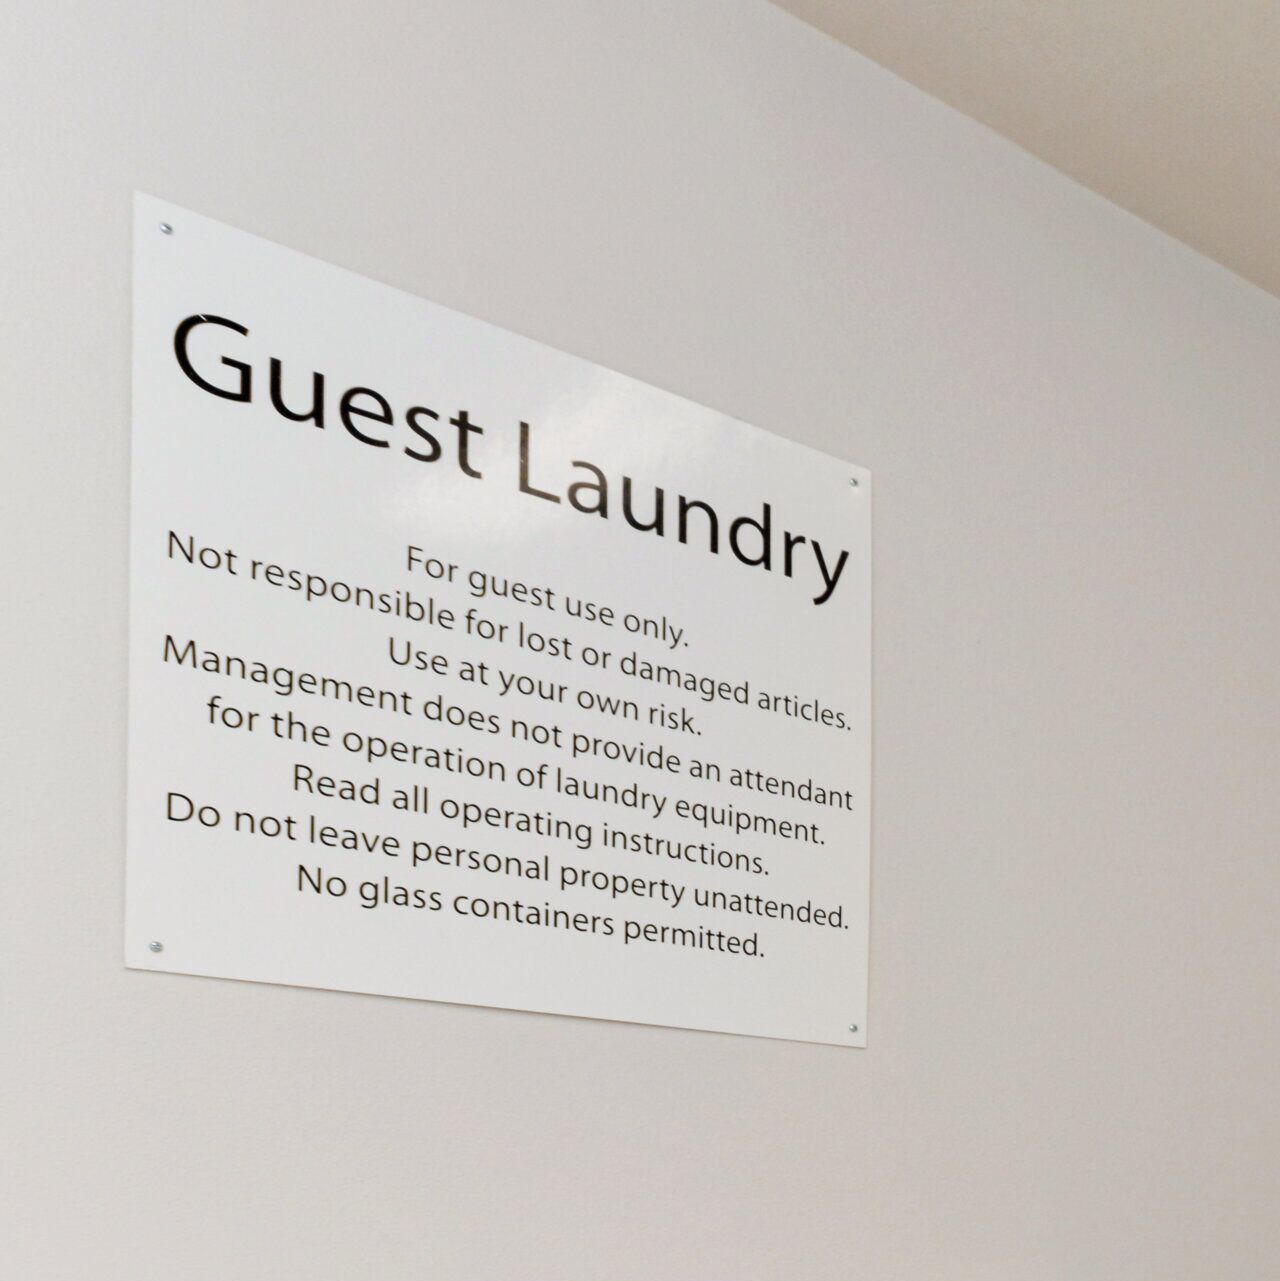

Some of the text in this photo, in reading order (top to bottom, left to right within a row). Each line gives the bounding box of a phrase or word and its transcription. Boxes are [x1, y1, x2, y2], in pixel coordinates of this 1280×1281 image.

[172, 313, 850, 606] Guest Laundry
[168, 529, 852, 731] Not responsible for lost or damaged articles.
[407, 544, 689, 650] For guest use only.
[163, 634, 853, 811] Management does not provide an attendant
[389, 636, 702, 736] Use at your own risk.
[206, 694, 825, 846] for the operation of laundry equipment.
[293, 763, 769, 876] Read all operating instructions.
[166, 791, 849, 930] Do not leave personal property unattended.
[297, 863, 765, 958] No glass containers permitted.
